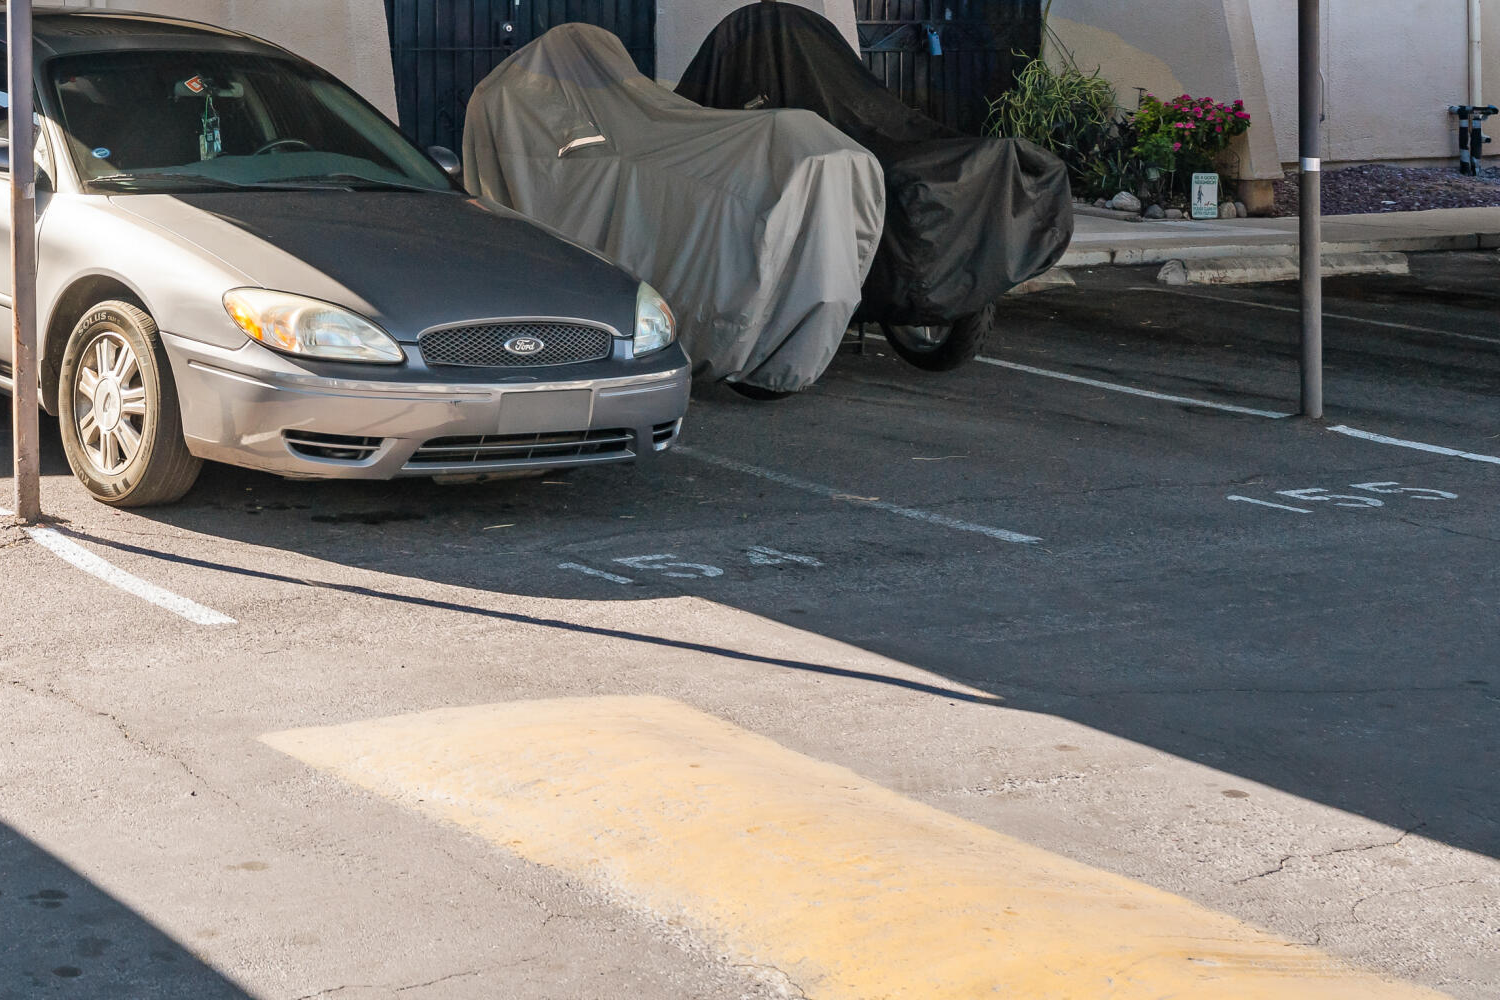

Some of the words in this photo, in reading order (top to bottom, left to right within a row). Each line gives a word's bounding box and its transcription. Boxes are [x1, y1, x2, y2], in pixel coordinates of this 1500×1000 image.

[77, 312, 107, 336] SOLUS
[515, 339, 536, 351] Ford
[1226, 480, 1459, 514] 155
